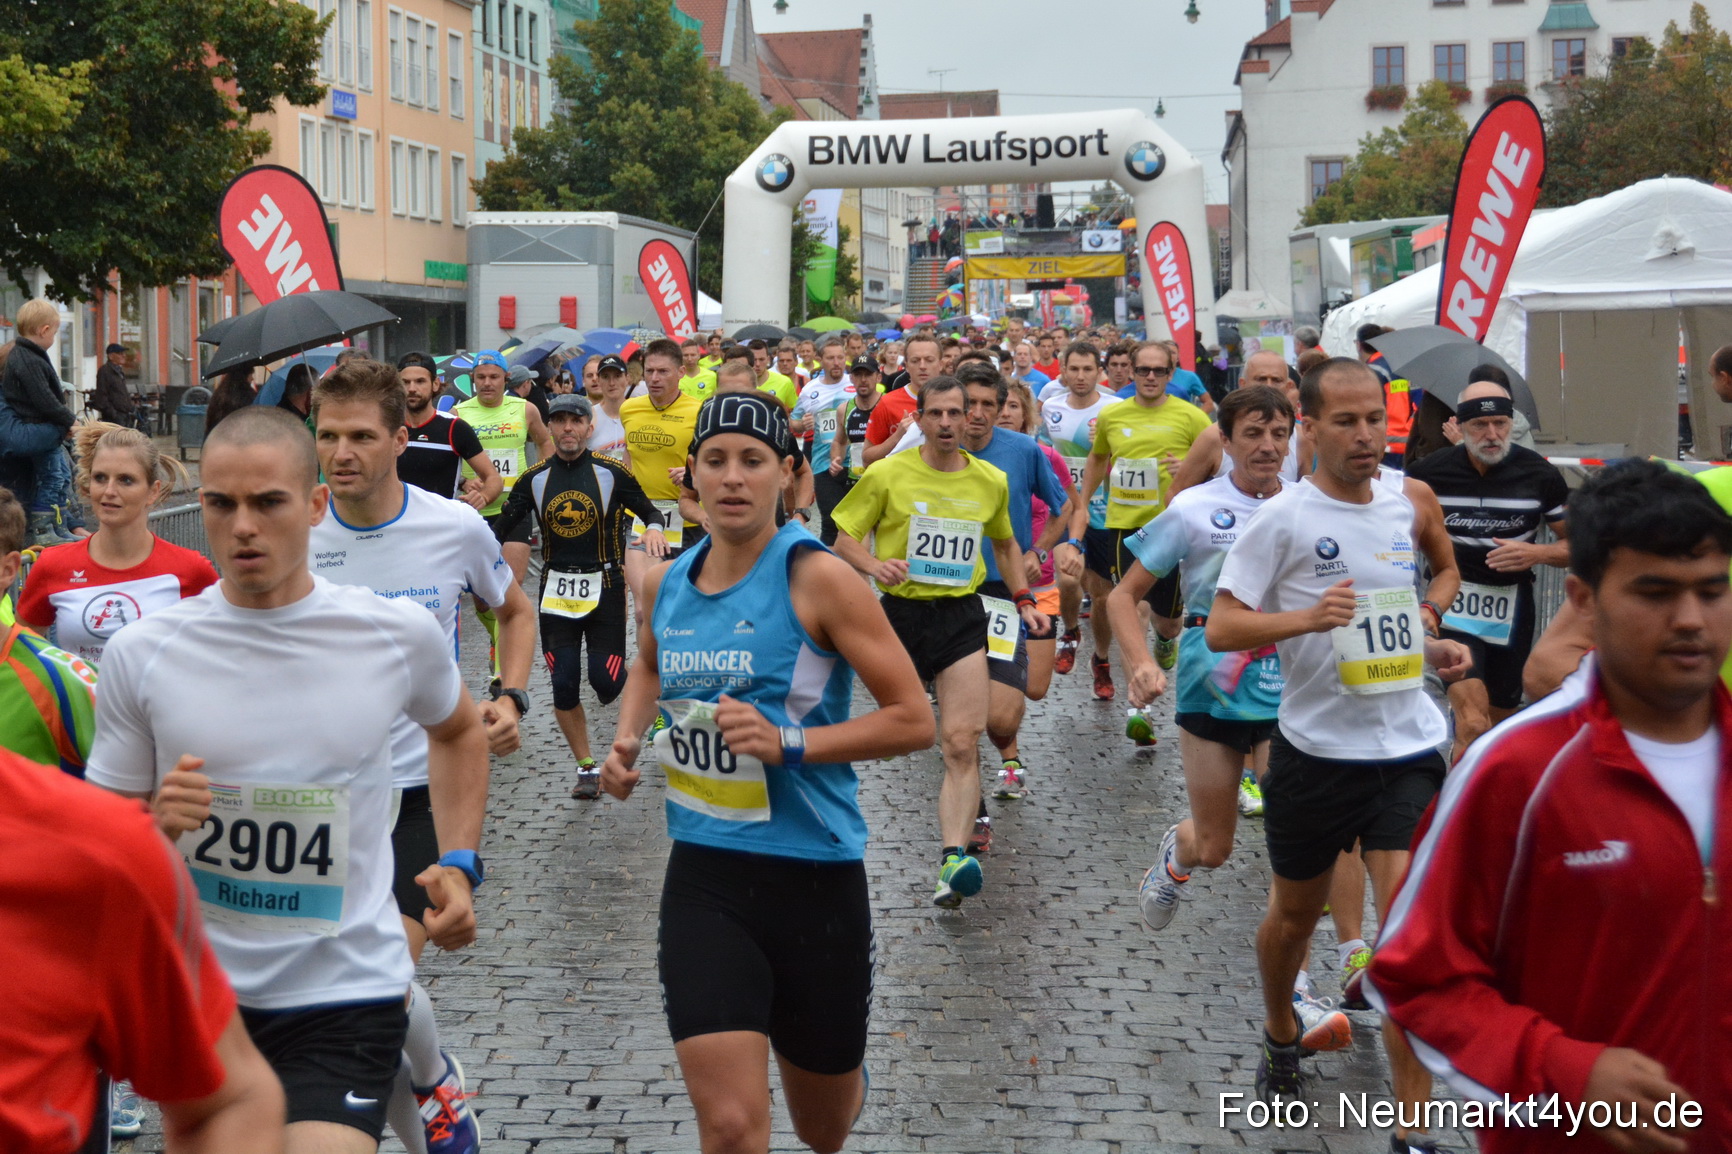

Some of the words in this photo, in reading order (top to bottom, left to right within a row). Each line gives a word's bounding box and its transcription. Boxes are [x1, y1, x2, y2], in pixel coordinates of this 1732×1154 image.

[808, 134, 912, 166] BMW
[923, 128, 1110, 167] Laufsport
[1447, 130, 1531, 340] REWE
[1028, 260, 1064, 275] ZIEL
[1119, 470, 1146, 488] 171
[548, 490, 594, 512] CONTINENTAL
[1120, 491, 1145, 499] Thomas
[550, 517, 594, 539] CONTINENTAL
[1444, 512, 1525, 533] Campagnolo
[314, 550, 347, 560] Wolfgang
[915, 532, 974, 562] 2010
[316, 559, 345, 569] Hofbeck
[924, 563, 960, 577] Damian
[1315, 560, 1348, 572] PARTL
[1315, 568, 1349, 578] Neumarkt
[556, 577, 590, 599] 618
[425, 599, 440, 609] eG
[1451, 590, 1509, 620] 3080
[1356, 612, 1412, 653] 168
[662, 649, 755, 675] ERDINGER
[1261, 657, 1278, 671] 17.
[1366, 661, 1409, 680] Michael
[663, 676, 752, 688] ALKOHOLFREI
[669, 723, 737, 774] 606
[254, 788, 336, 807] BOCK
[194, 814, 334, 876] 2904
[218, 880, 300, 912] Richard
